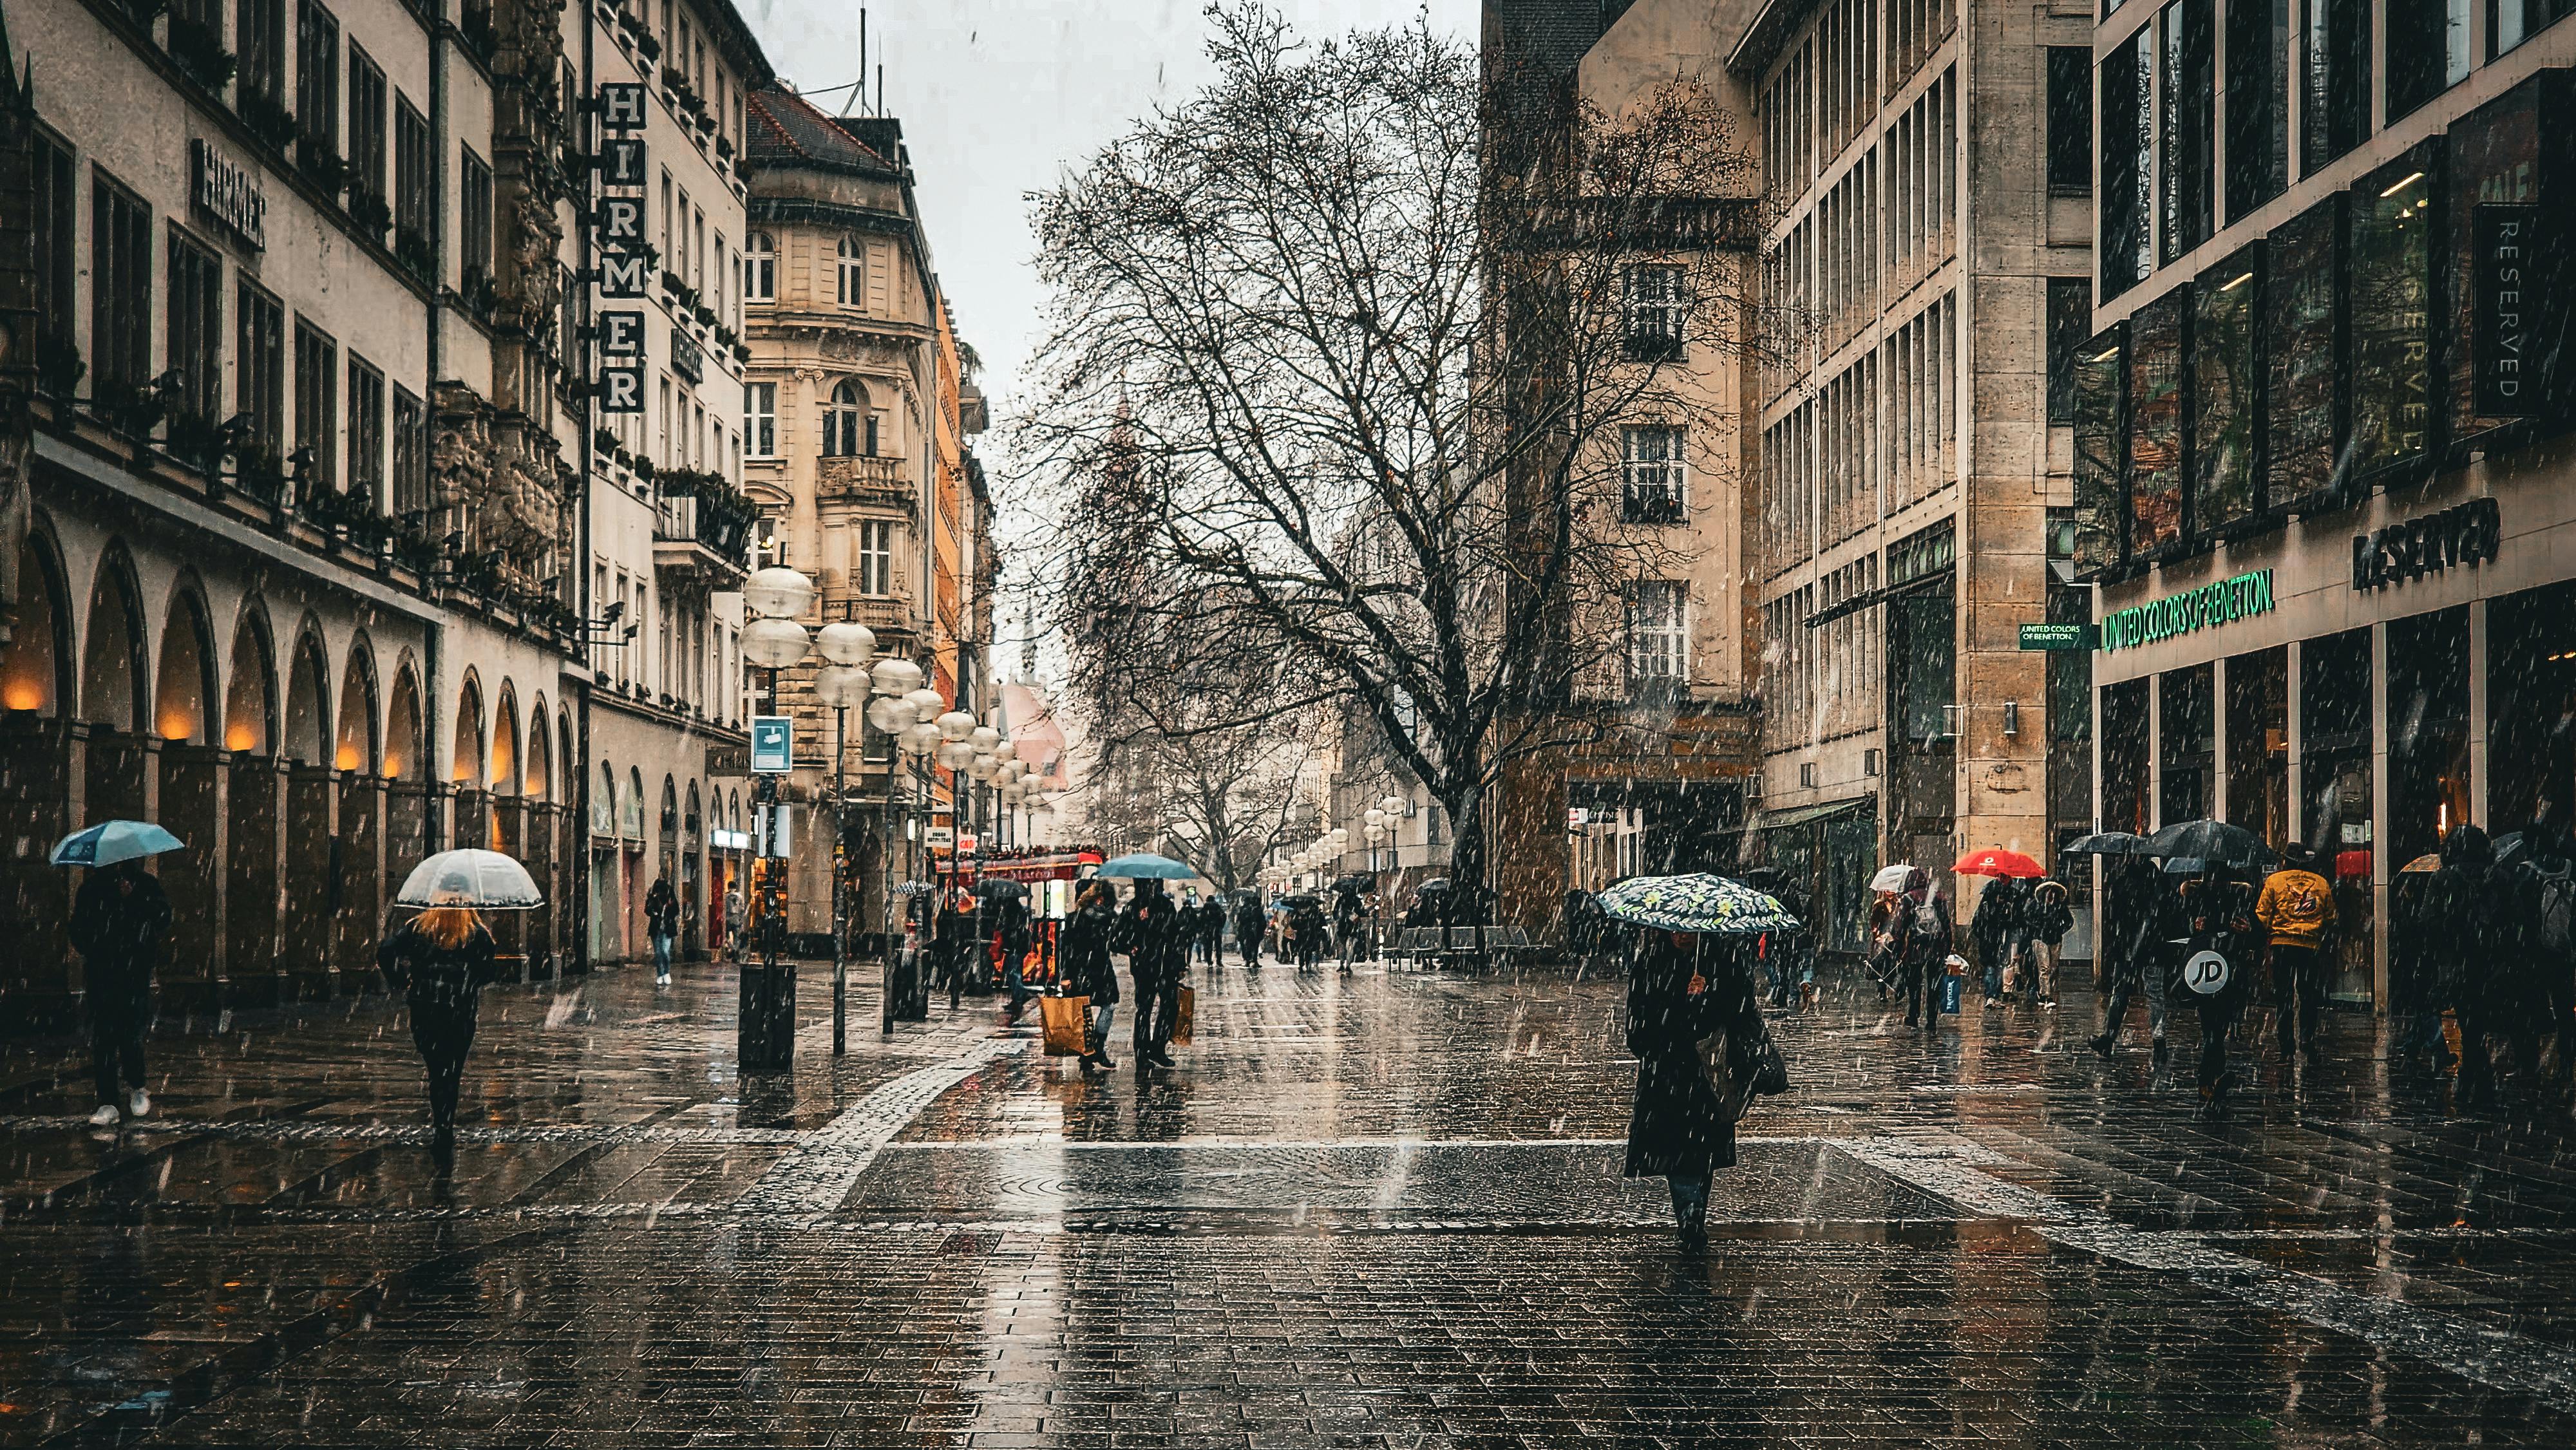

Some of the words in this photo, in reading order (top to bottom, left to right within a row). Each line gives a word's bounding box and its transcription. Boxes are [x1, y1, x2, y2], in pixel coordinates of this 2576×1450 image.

[602, 88, 643, 407] HIRMER
[2499, 221, 2519, 397] RESERVED
[2352, 496, 2501, 590] RESERVED
[2020, 625, 2049, 634] UNITED
[2102, 607, 2143, 653] UNITED
[2143, 592, 2188, 642] COLORS
[2189, 587, 2207, 631] OF
[2192, 960, 2224, 986] JD
